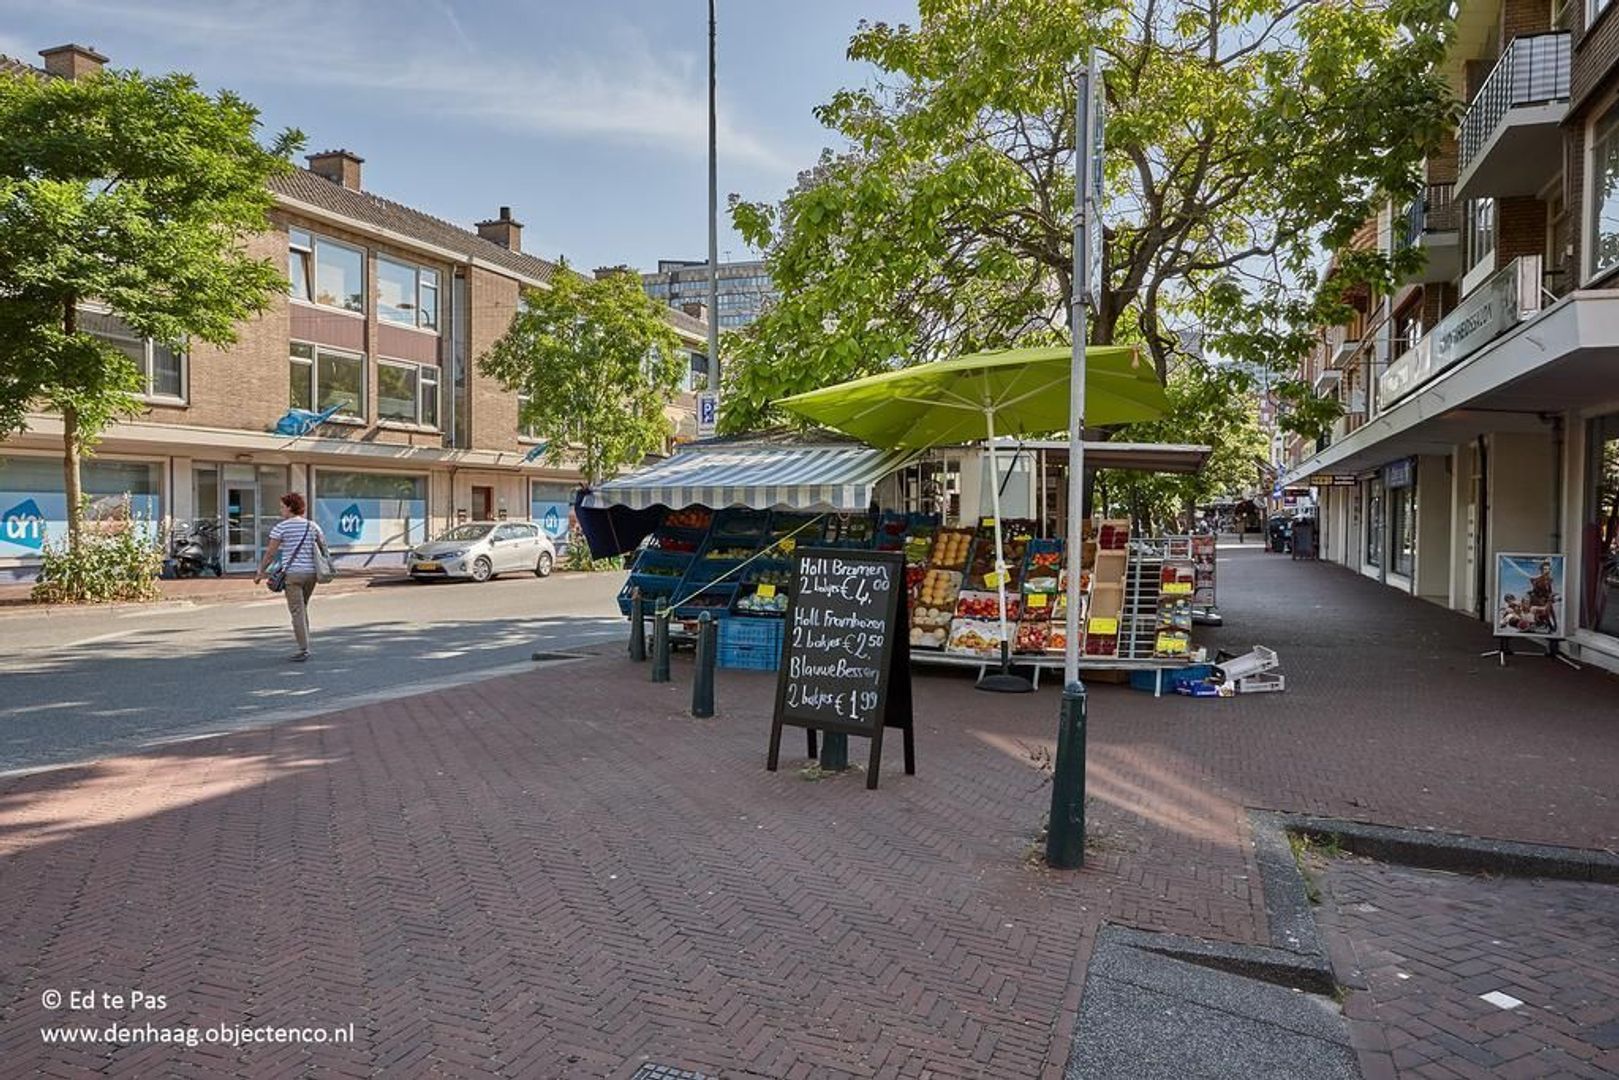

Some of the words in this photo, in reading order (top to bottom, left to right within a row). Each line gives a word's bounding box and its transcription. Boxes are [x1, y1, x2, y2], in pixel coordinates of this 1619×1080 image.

[800, 557, 827, 575] Holl
[800, 576, 812, 594] 2
[792, 626, 802, 647] 2
[788, 683, 799, 708] 2
